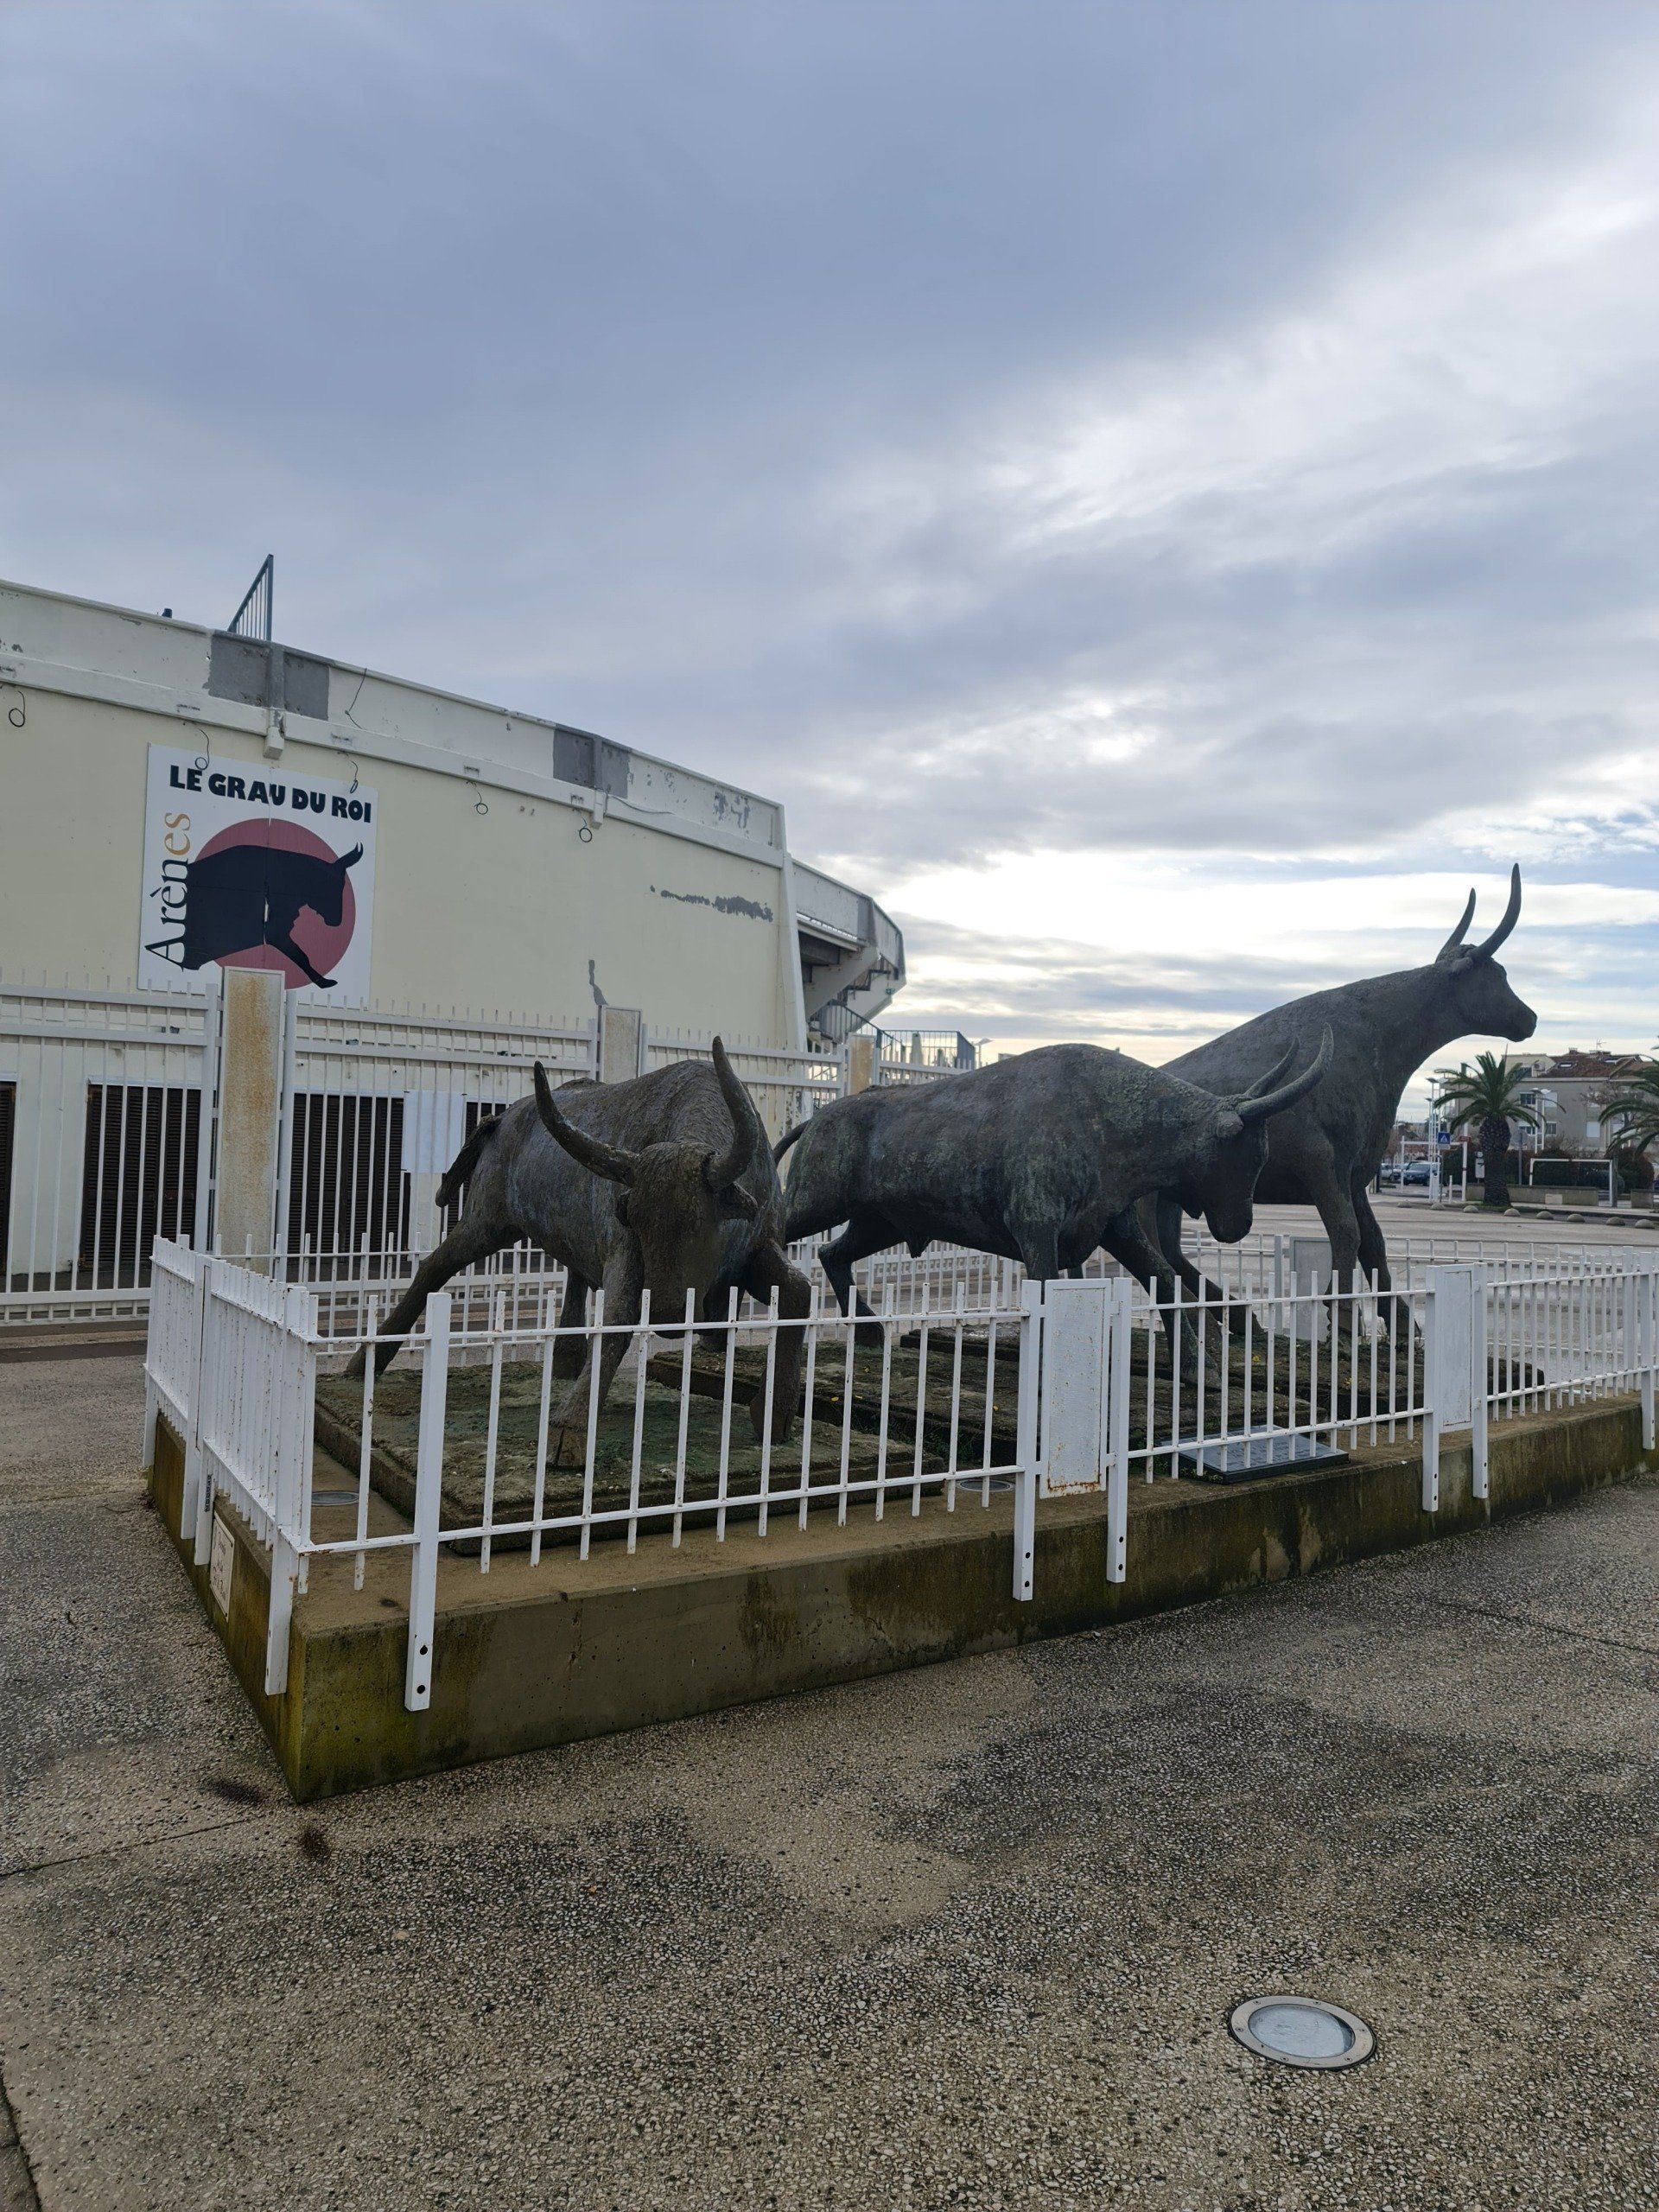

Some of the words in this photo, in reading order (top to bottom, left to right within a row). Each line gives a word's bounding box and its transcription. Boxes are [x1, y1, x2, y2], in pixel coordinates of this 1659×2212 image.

[169, 765, 203, 792] LE
[208, 773, 286, 806] GRAU
[291, 788, 326, 814] DU
[331, 795, 372, 823] ROI
[144, 812, 192, 972] Arènes
